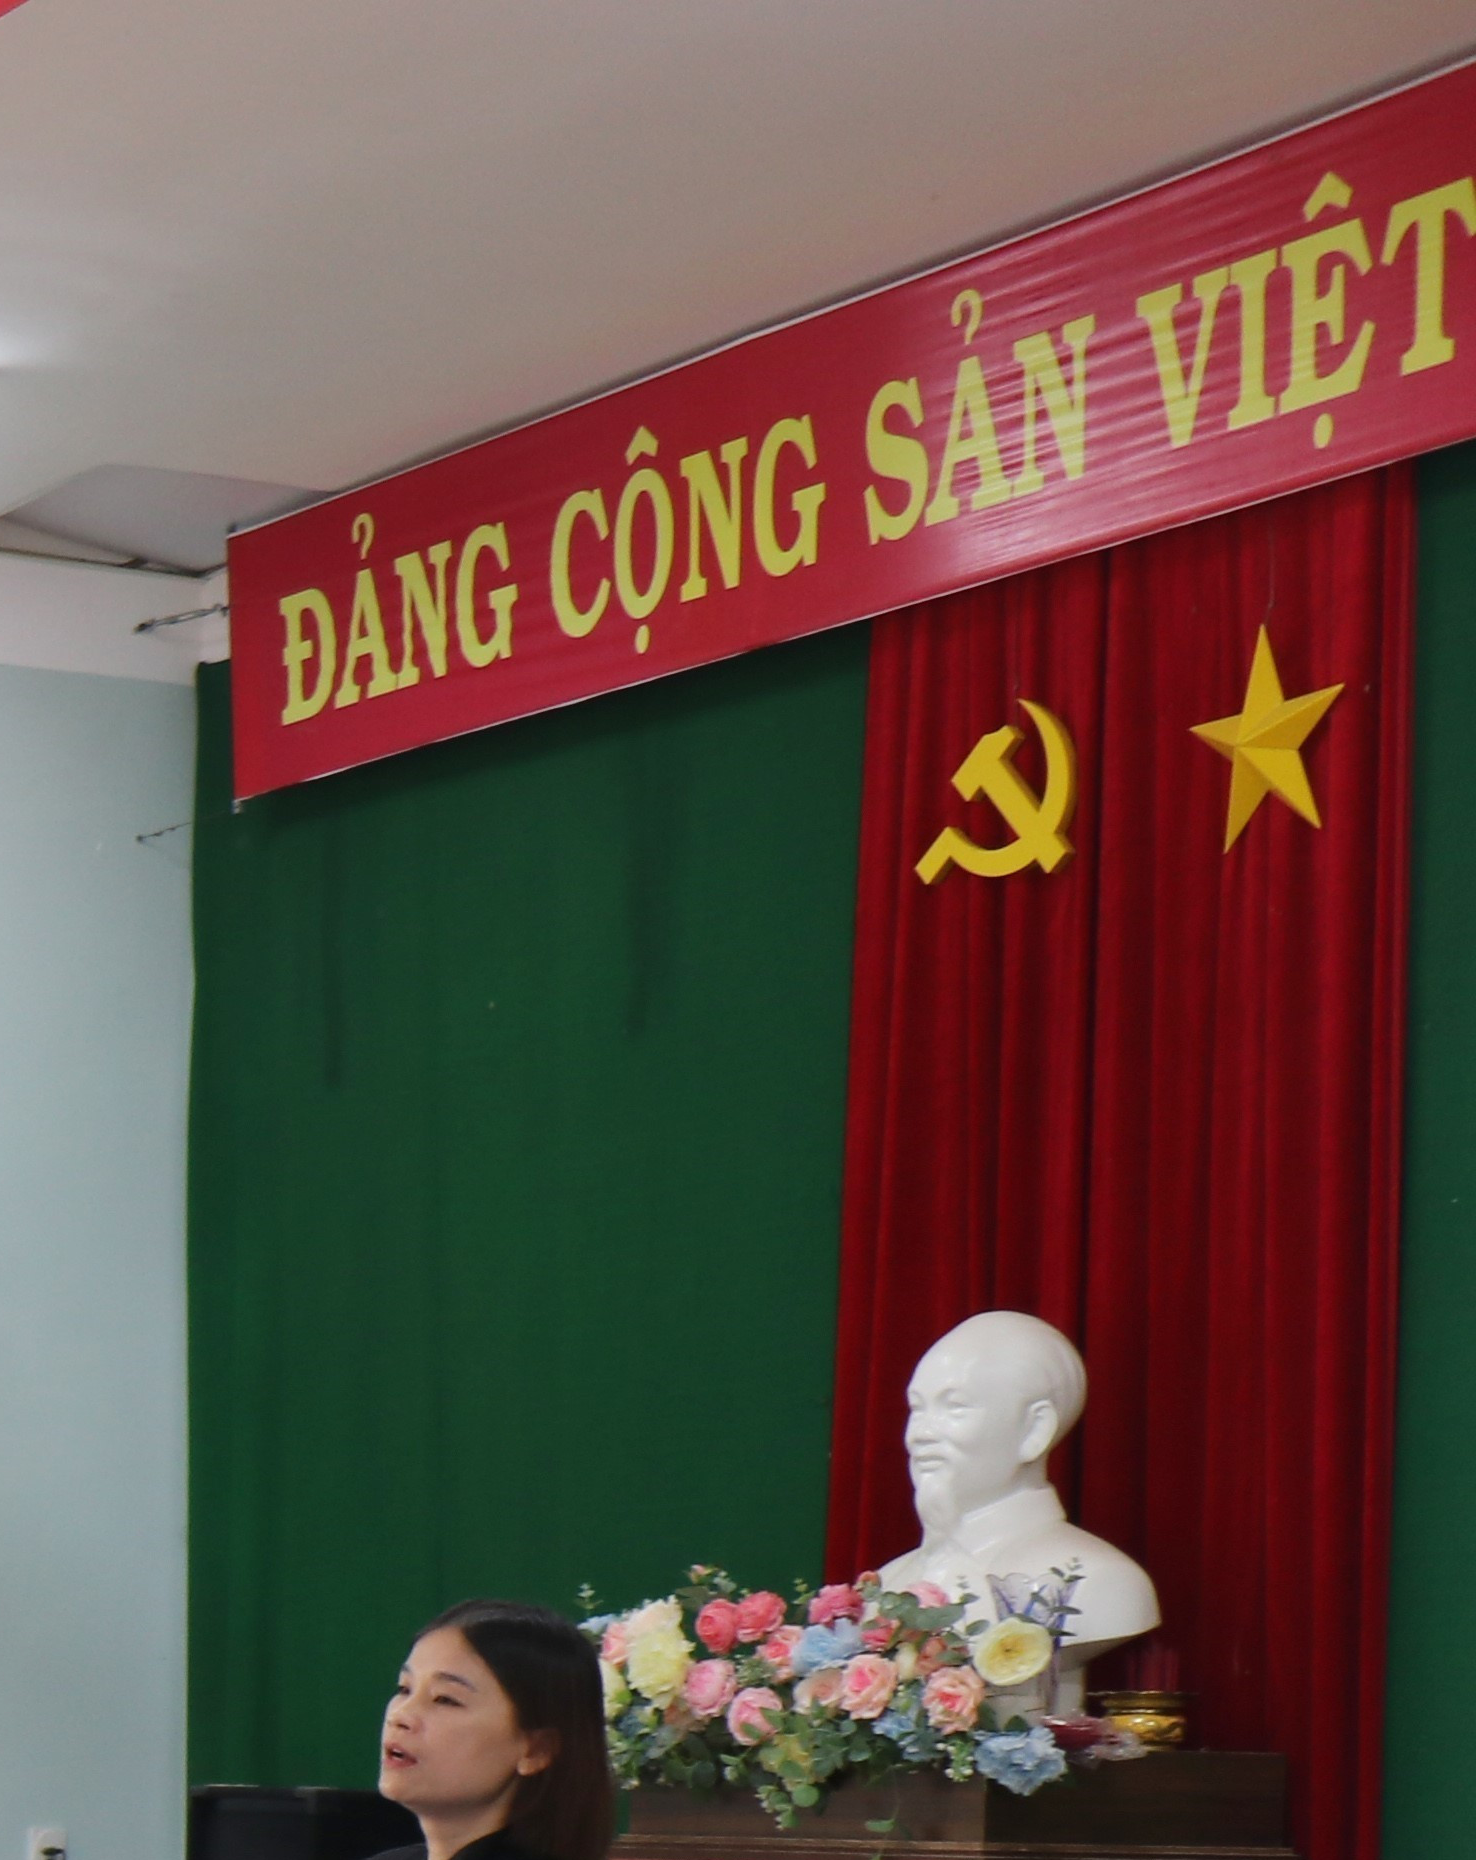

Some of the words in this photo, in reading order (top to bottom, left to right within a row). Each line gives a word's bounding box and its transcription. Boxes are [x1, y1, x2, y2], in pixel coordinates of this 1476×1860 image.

[279, 513, 518, 725] ĐẢNG
[551, 425, 827, 654] CỘNG
[864, 288, 1096, 545] SẢN
[1136, 171, 1476, 449] VIỆT
